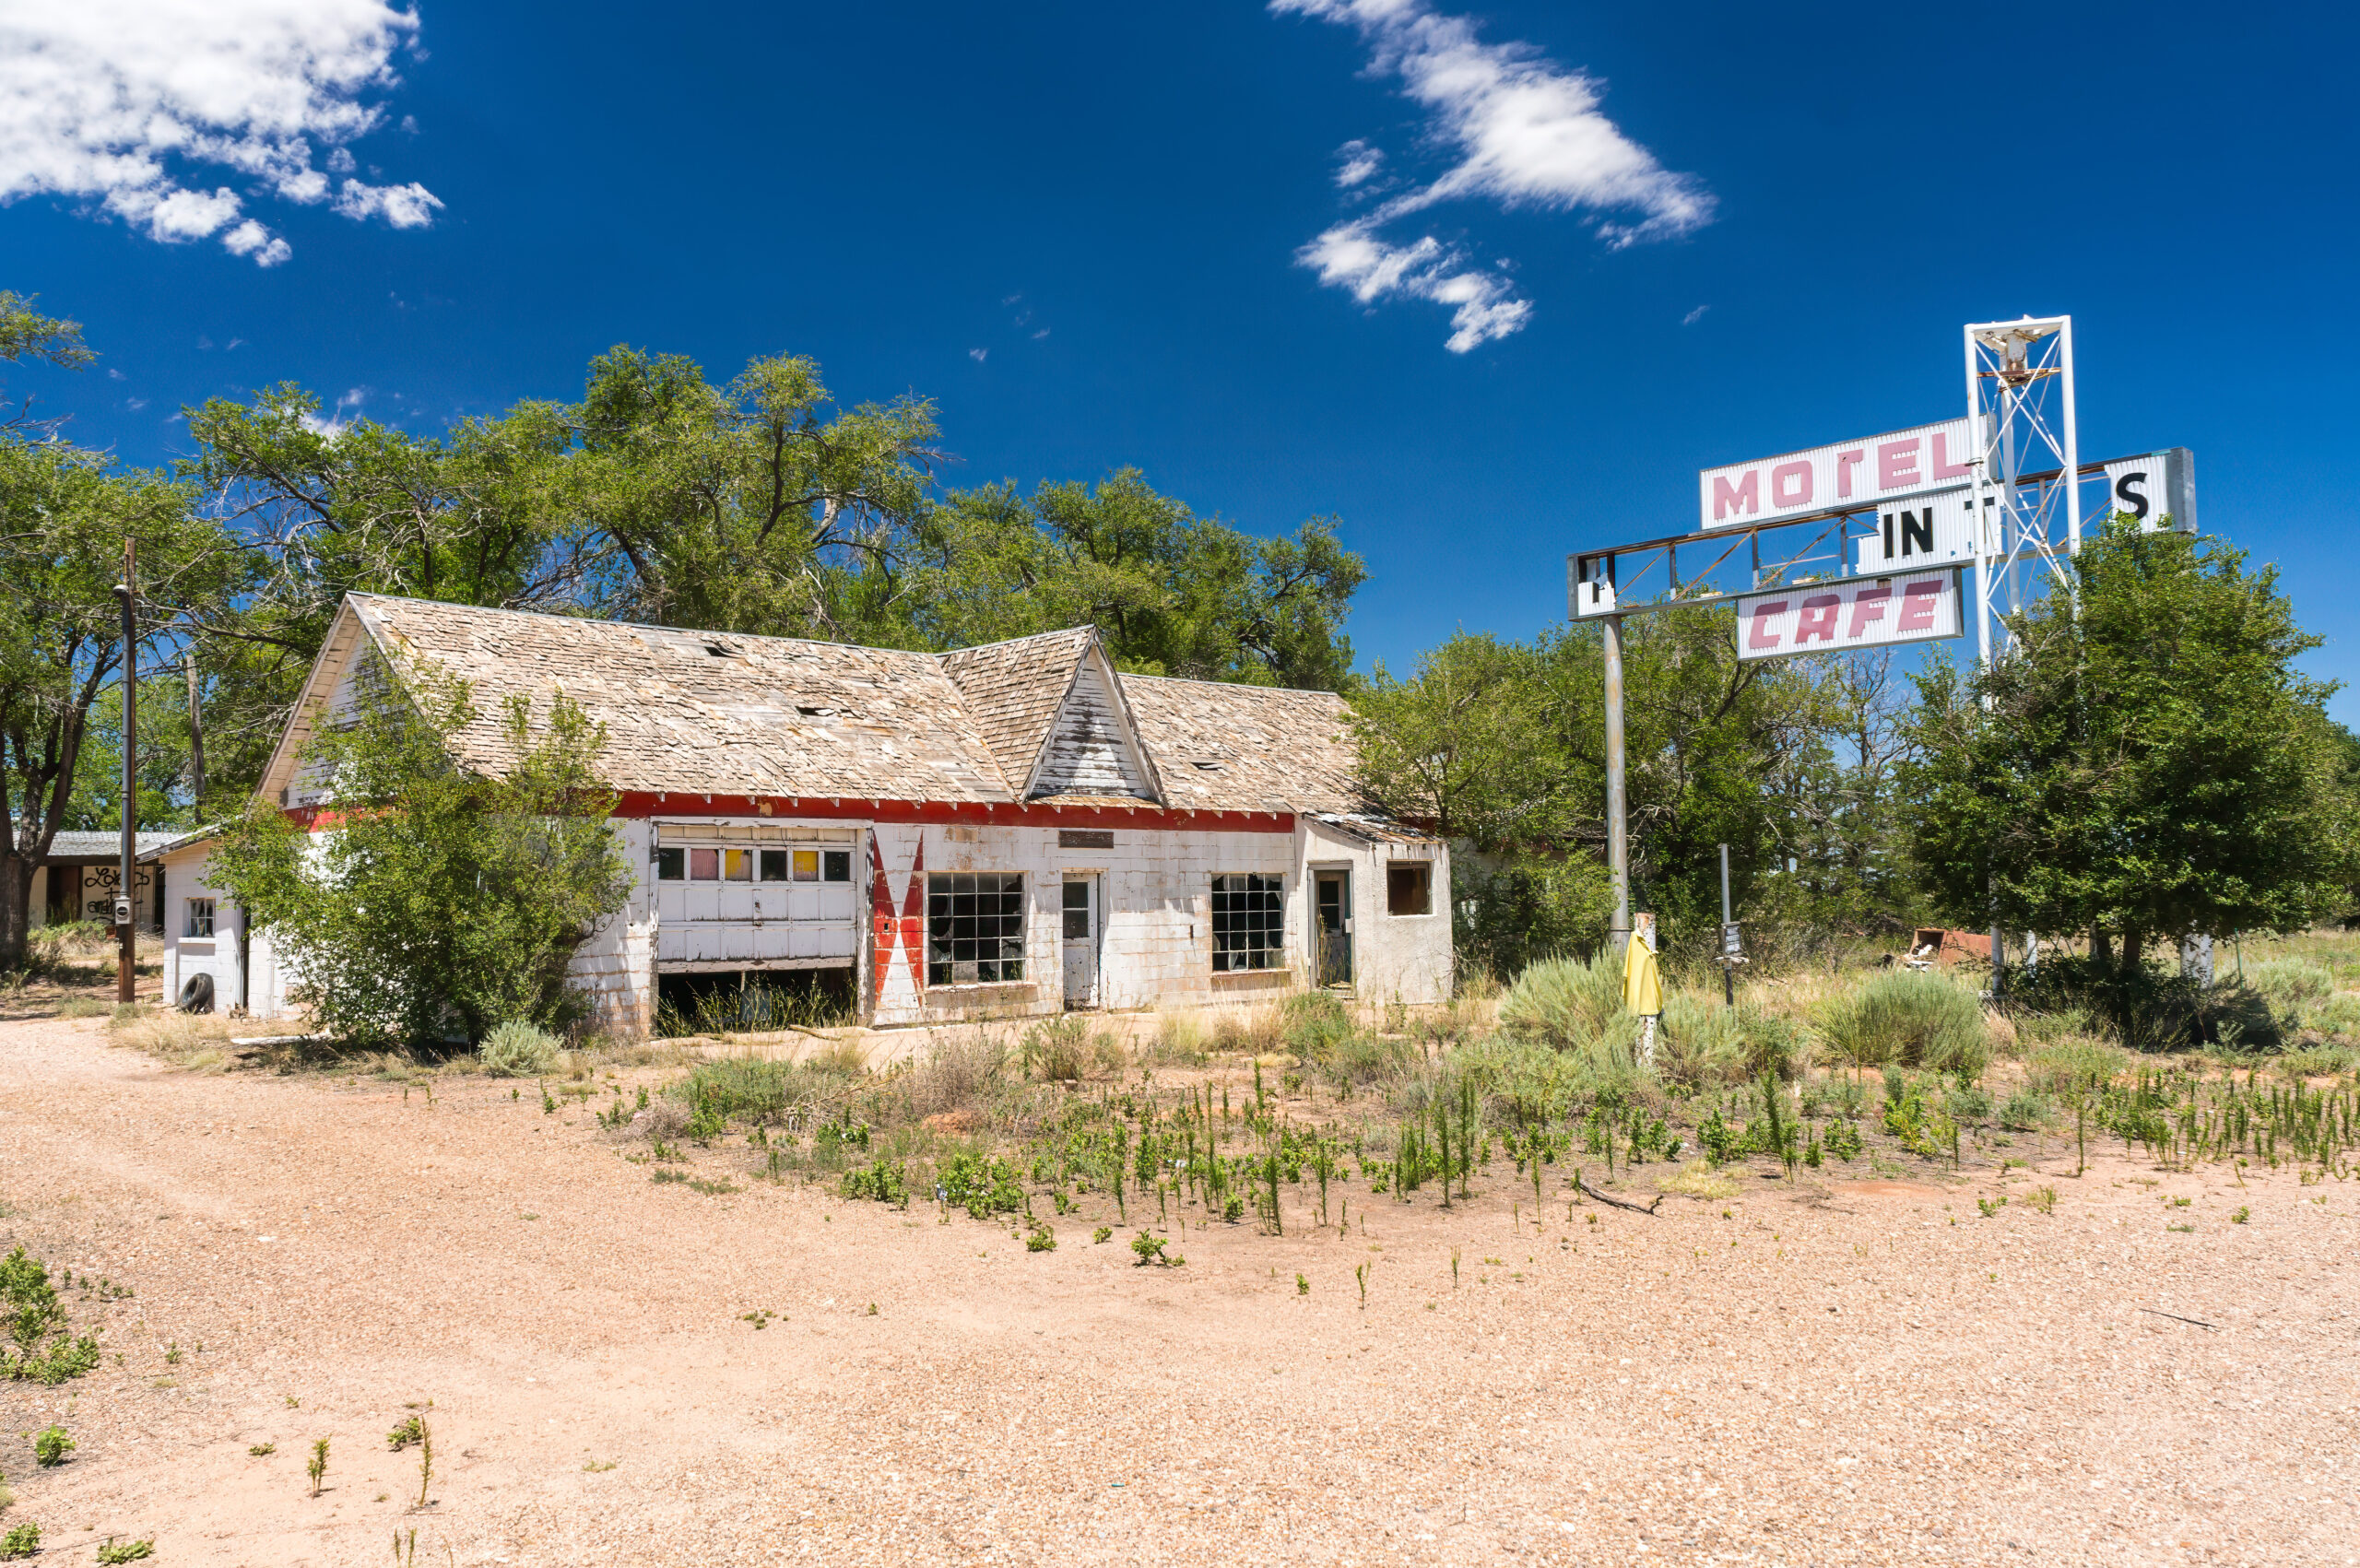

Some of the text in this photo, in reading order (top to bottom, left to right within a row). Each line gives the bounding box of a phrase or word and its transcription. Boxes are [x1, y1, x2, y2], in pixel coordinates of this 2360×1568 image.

[1713, 432, 1972, 520] MOTEL
[1883, 506, 1934, 560] IN
[1748, 579, 1943, 650] CAFE
